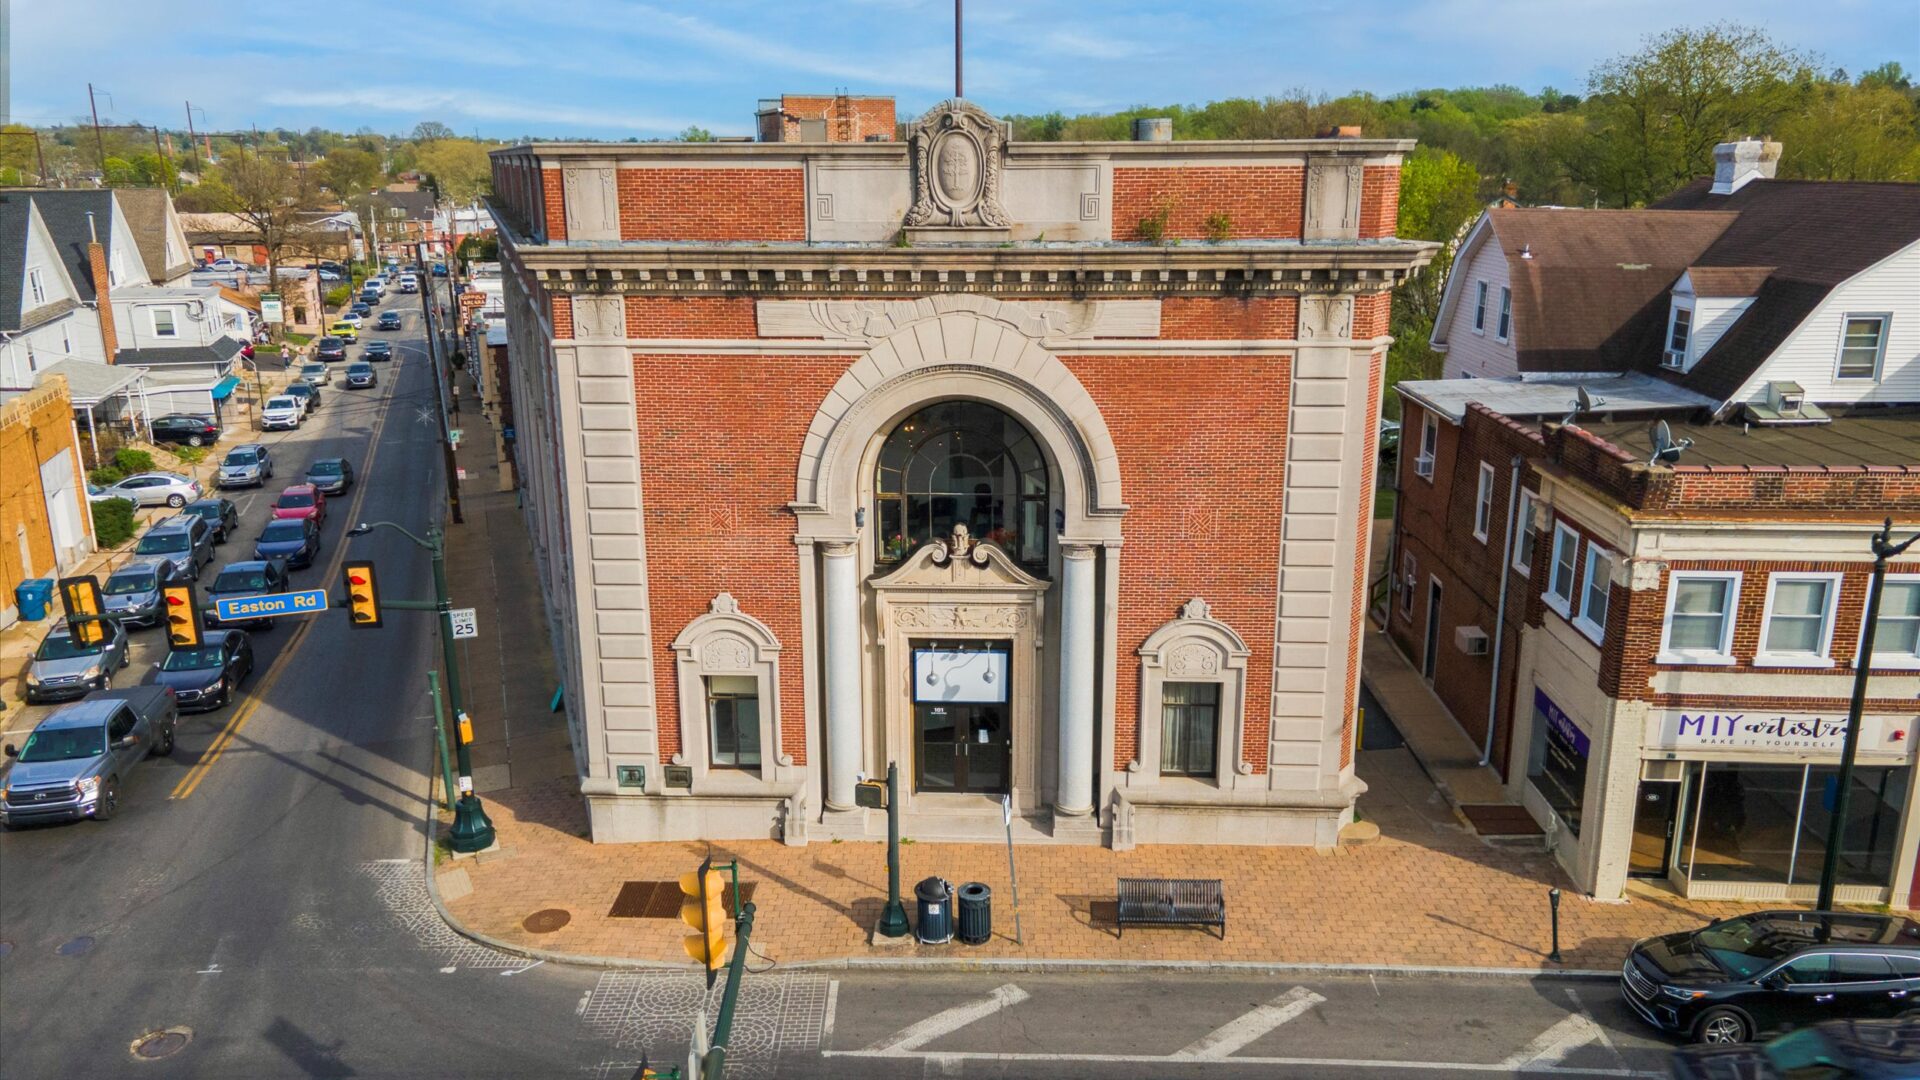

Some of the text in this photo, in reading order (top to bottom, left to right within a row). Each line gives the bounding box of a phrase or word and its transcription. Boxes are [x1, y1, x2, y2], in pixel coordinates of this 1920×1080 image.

[228, 595, 317, 615] Easton Rd
[455, 623, 474, 635] 25
[1678, 714, 1744, 737] MIY
[1766, 740, 1835, 748] YOURSELF
